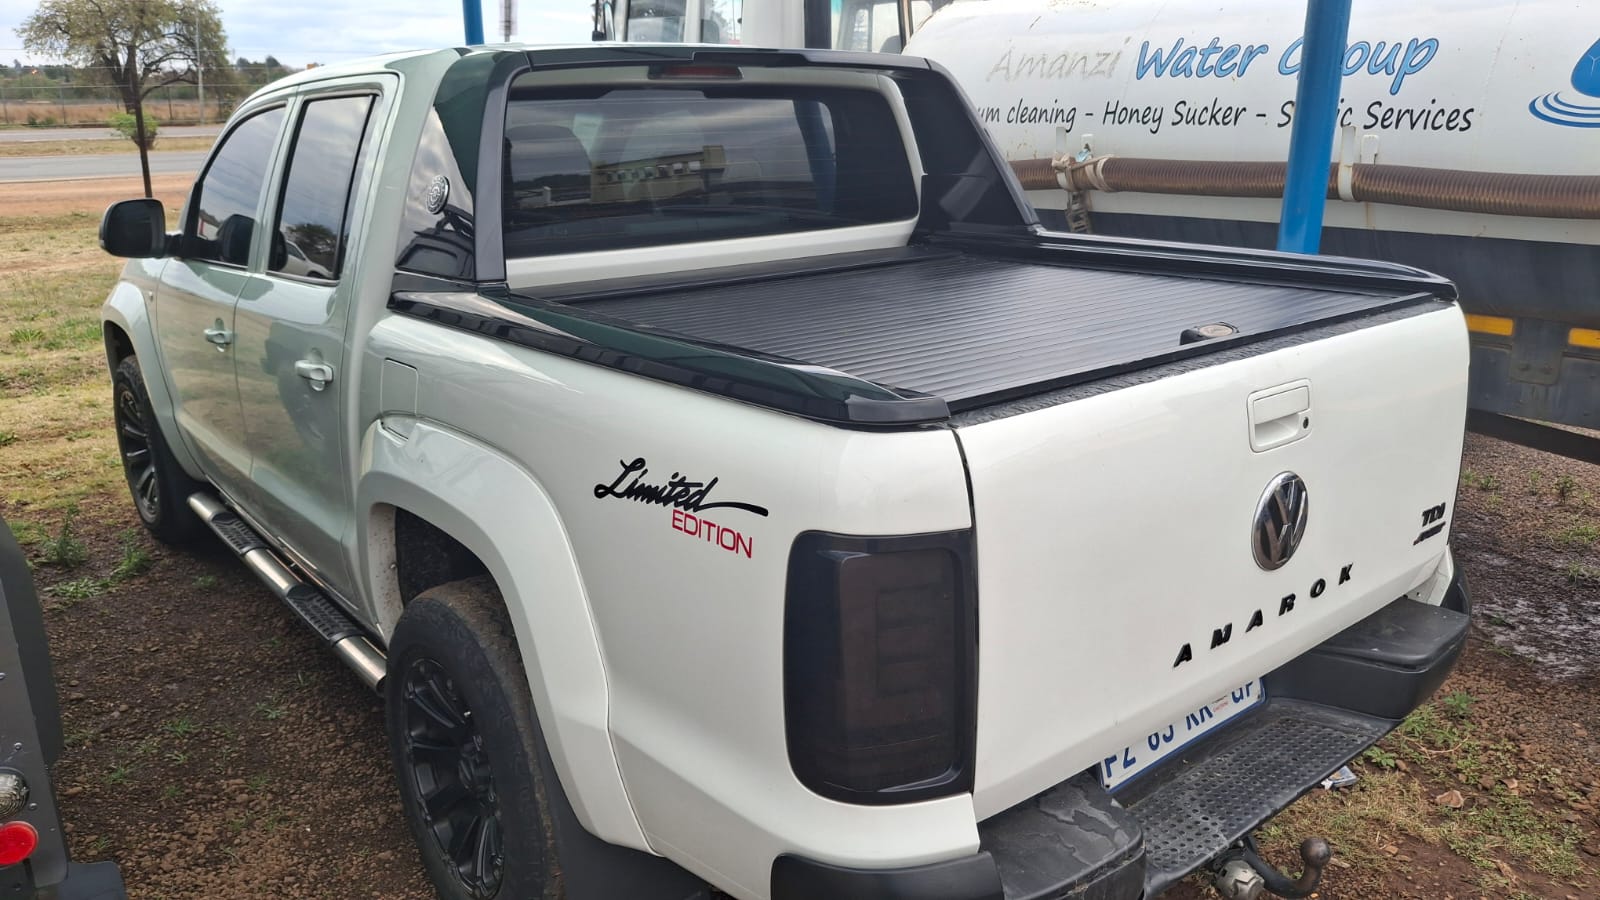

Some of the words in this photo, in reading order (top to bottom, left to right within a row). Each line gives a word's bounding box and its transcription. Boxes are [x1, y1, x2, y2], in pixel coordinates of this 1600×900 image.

[985, 36, 1132, 82] Amanzi
[1136, 36, 1269, 80] Water
[1277, 37, 1440, 96] Goup
[1006, 97, 1077, 133] cleaning
[1102, 99, 1164, 135] Honey
[1171, 97, 1247, 127] Sucker
[1277, 97, 1353, 128] Sic
[1363, 98, 1475, 132] Services
[593, 457, 769, 517] Limited
[672, 509, 752, 559] EDITION
[1172, 562, 1354, 668] AMAROK
